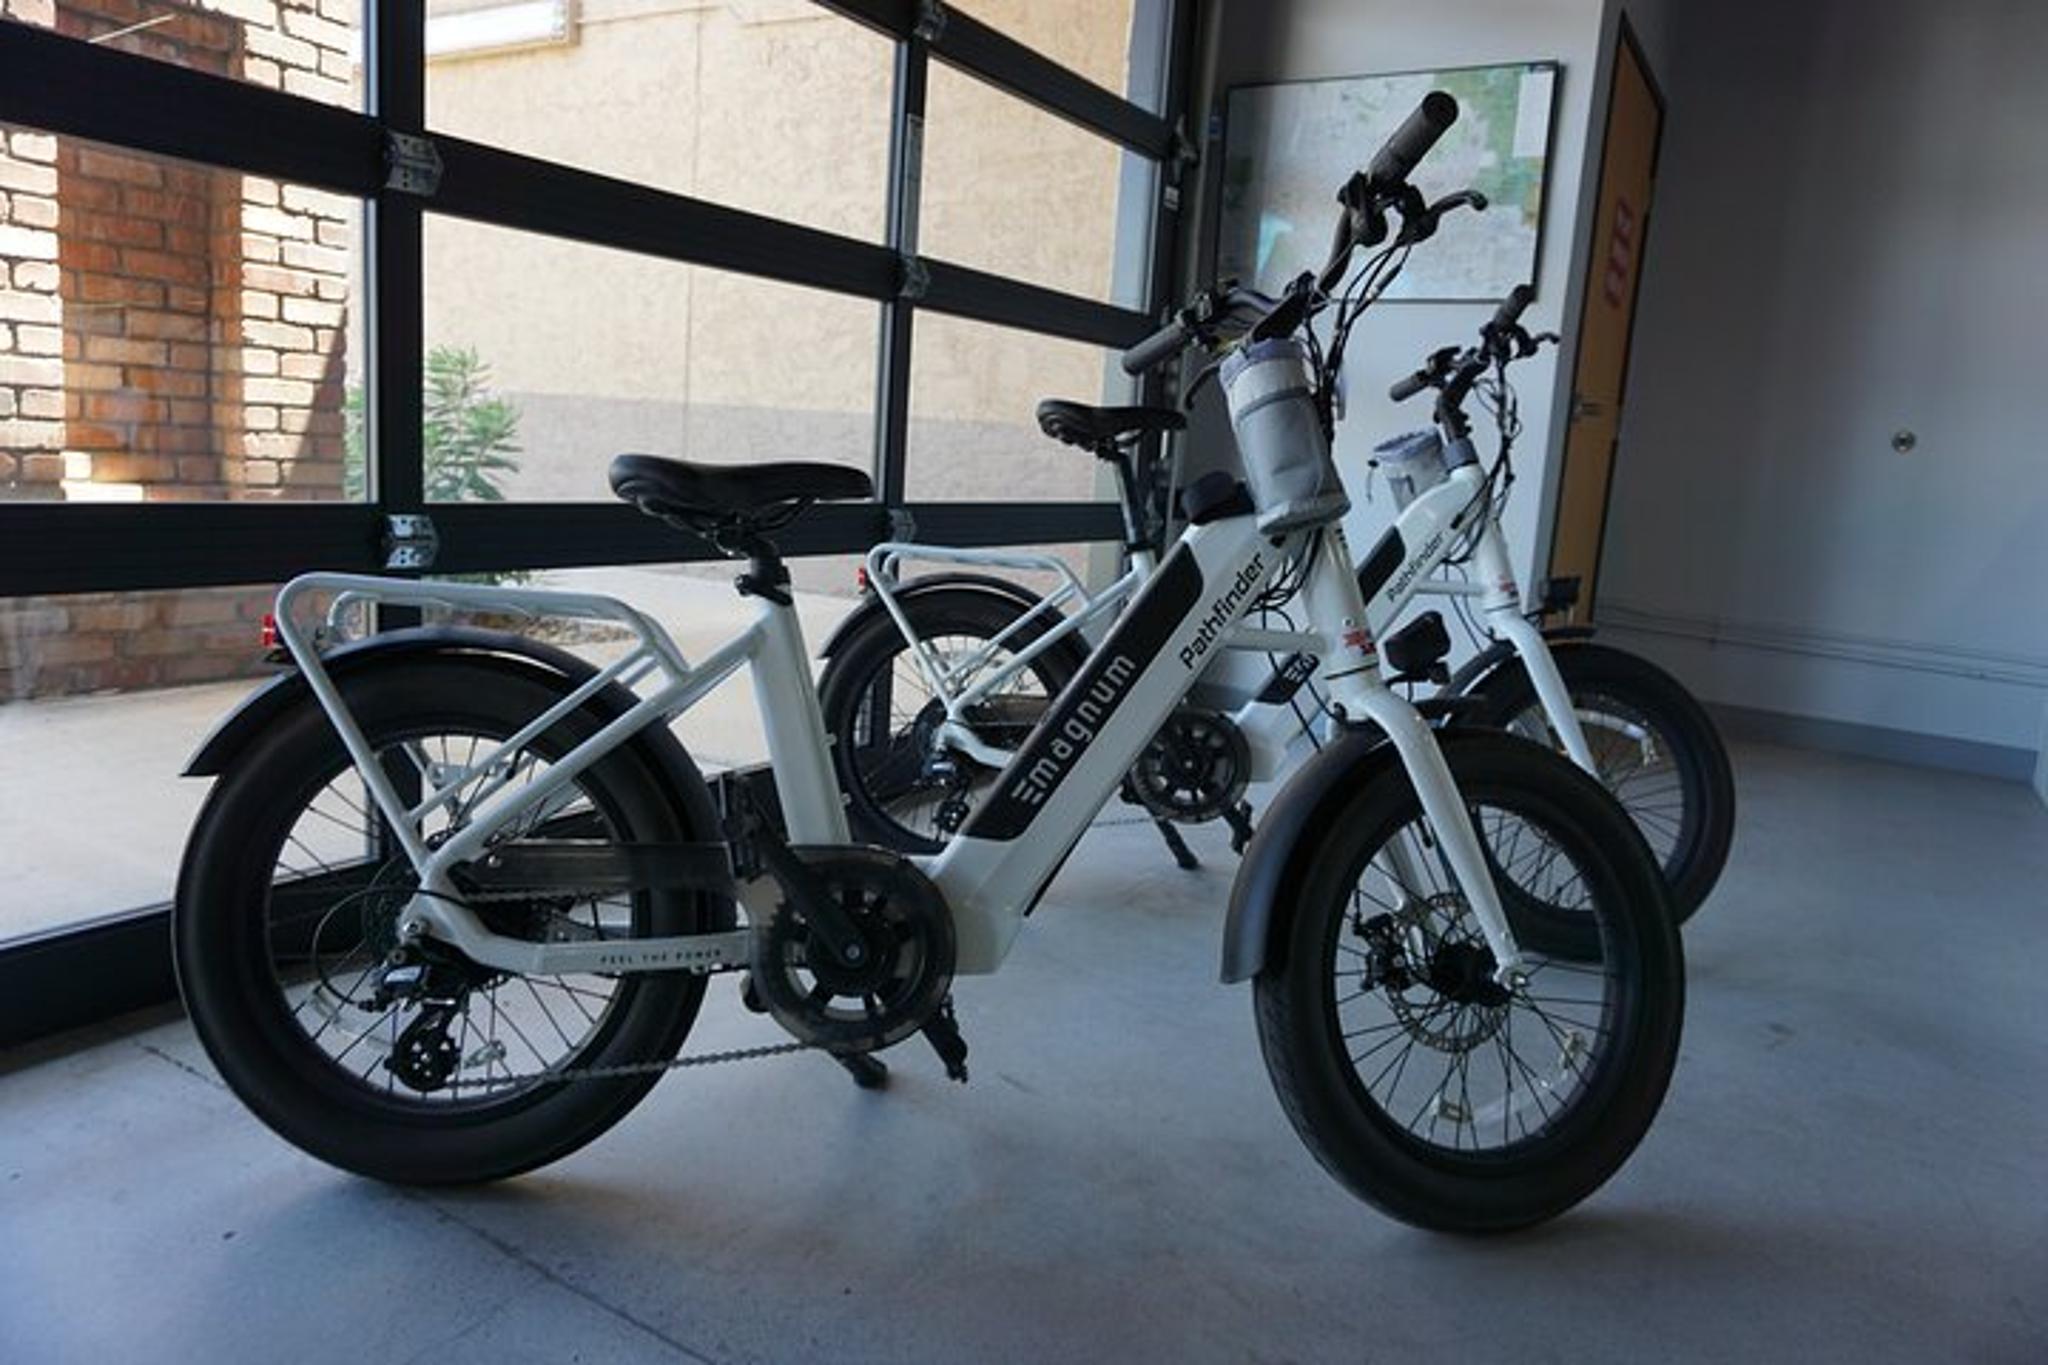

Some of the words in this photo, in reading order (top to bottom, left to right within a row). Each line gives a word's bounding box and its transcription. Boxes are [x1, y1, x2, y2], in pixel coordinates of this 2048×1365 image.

[1179, 552, 1265, 671] Pathfinder
[601, 955, 633, 965] FEEL
[642, 953, 667, 962] THE
[675, 949, 721, 961] POWER
